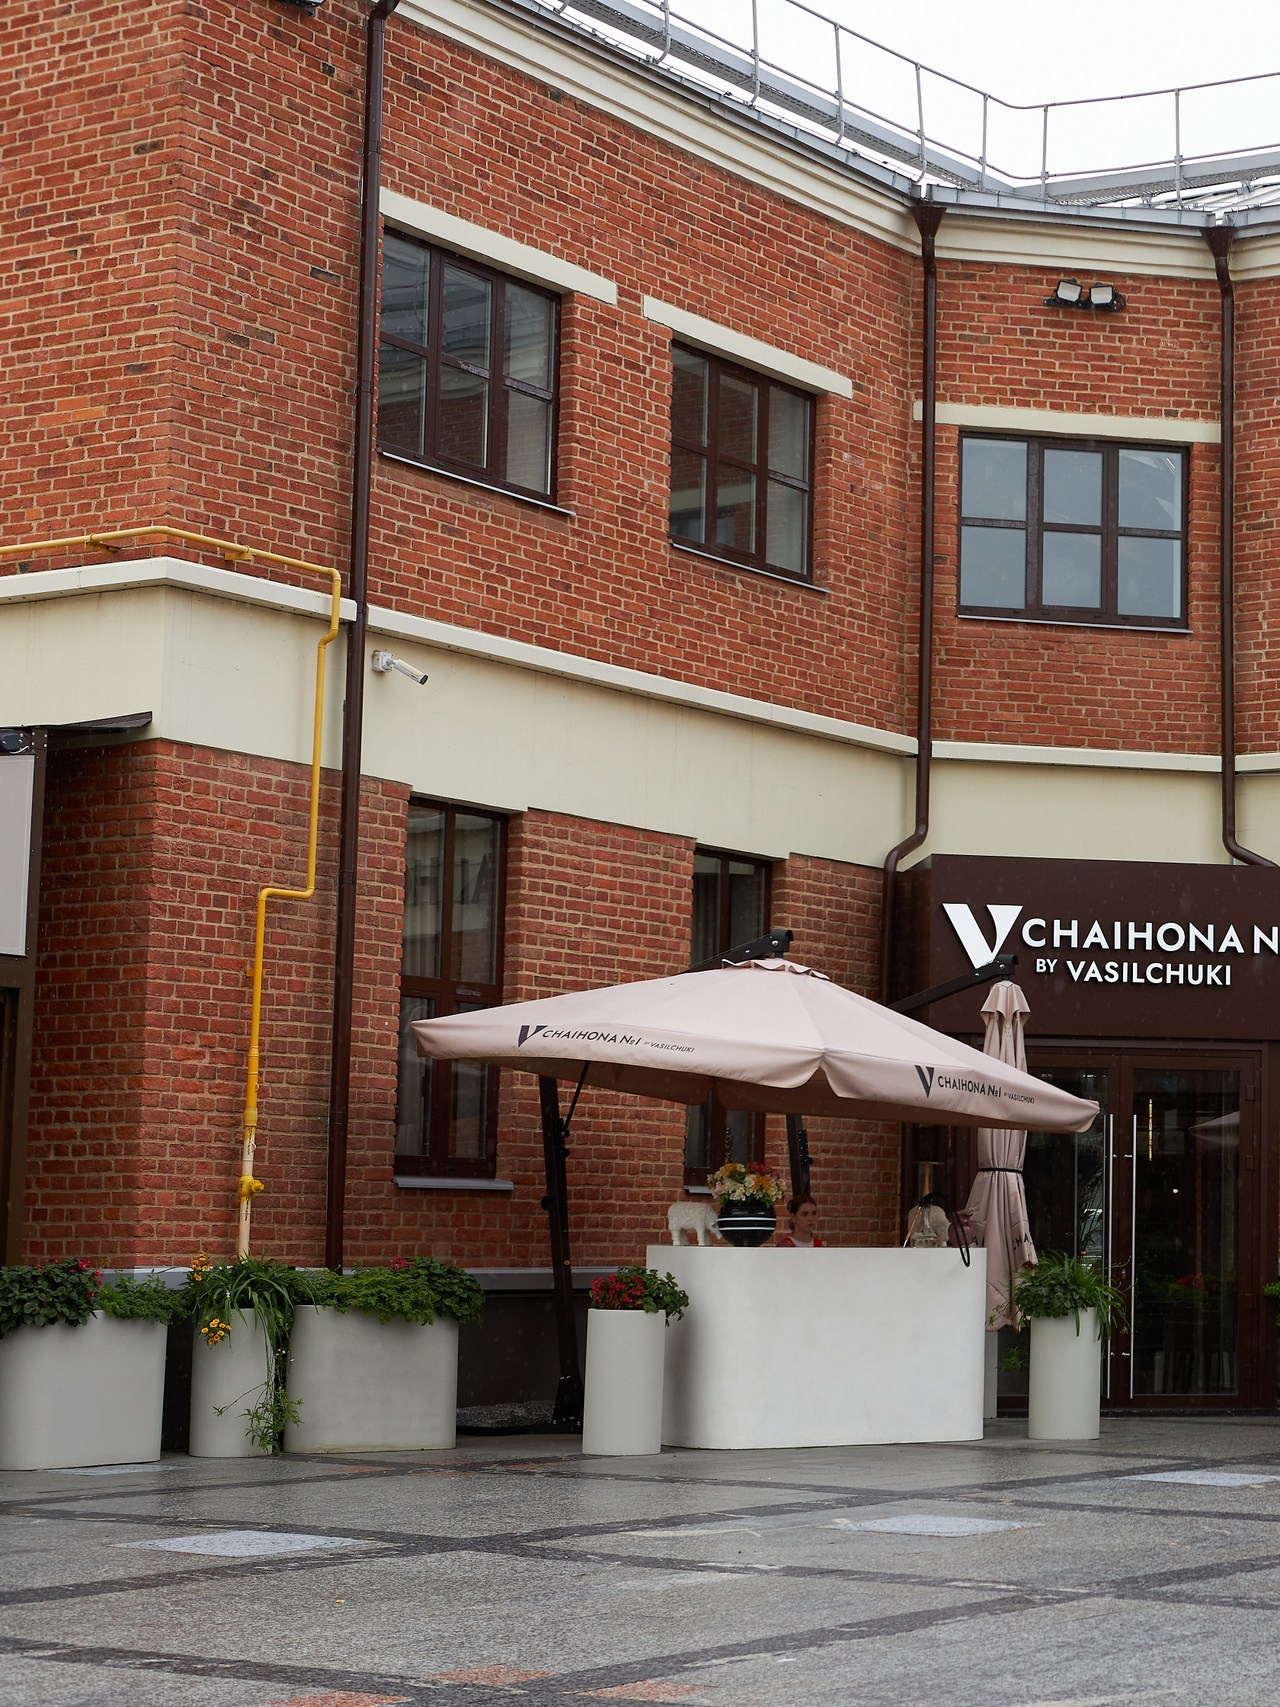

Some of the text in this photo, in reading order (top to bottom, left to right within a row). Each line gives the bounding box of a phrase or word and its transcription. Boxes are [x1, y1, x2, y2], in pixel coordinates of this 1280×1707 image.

[1022, 917, 1245, 954] CHAIHONA
[1035, 958, 1232, 986] BY VASILCHUKI
[542, 1029, 617, 1044] CHAIHONA
[650, 1042, 695, 1053] VASILCHUKI
[937, 1075, 986, 1096] CHAIHONA
